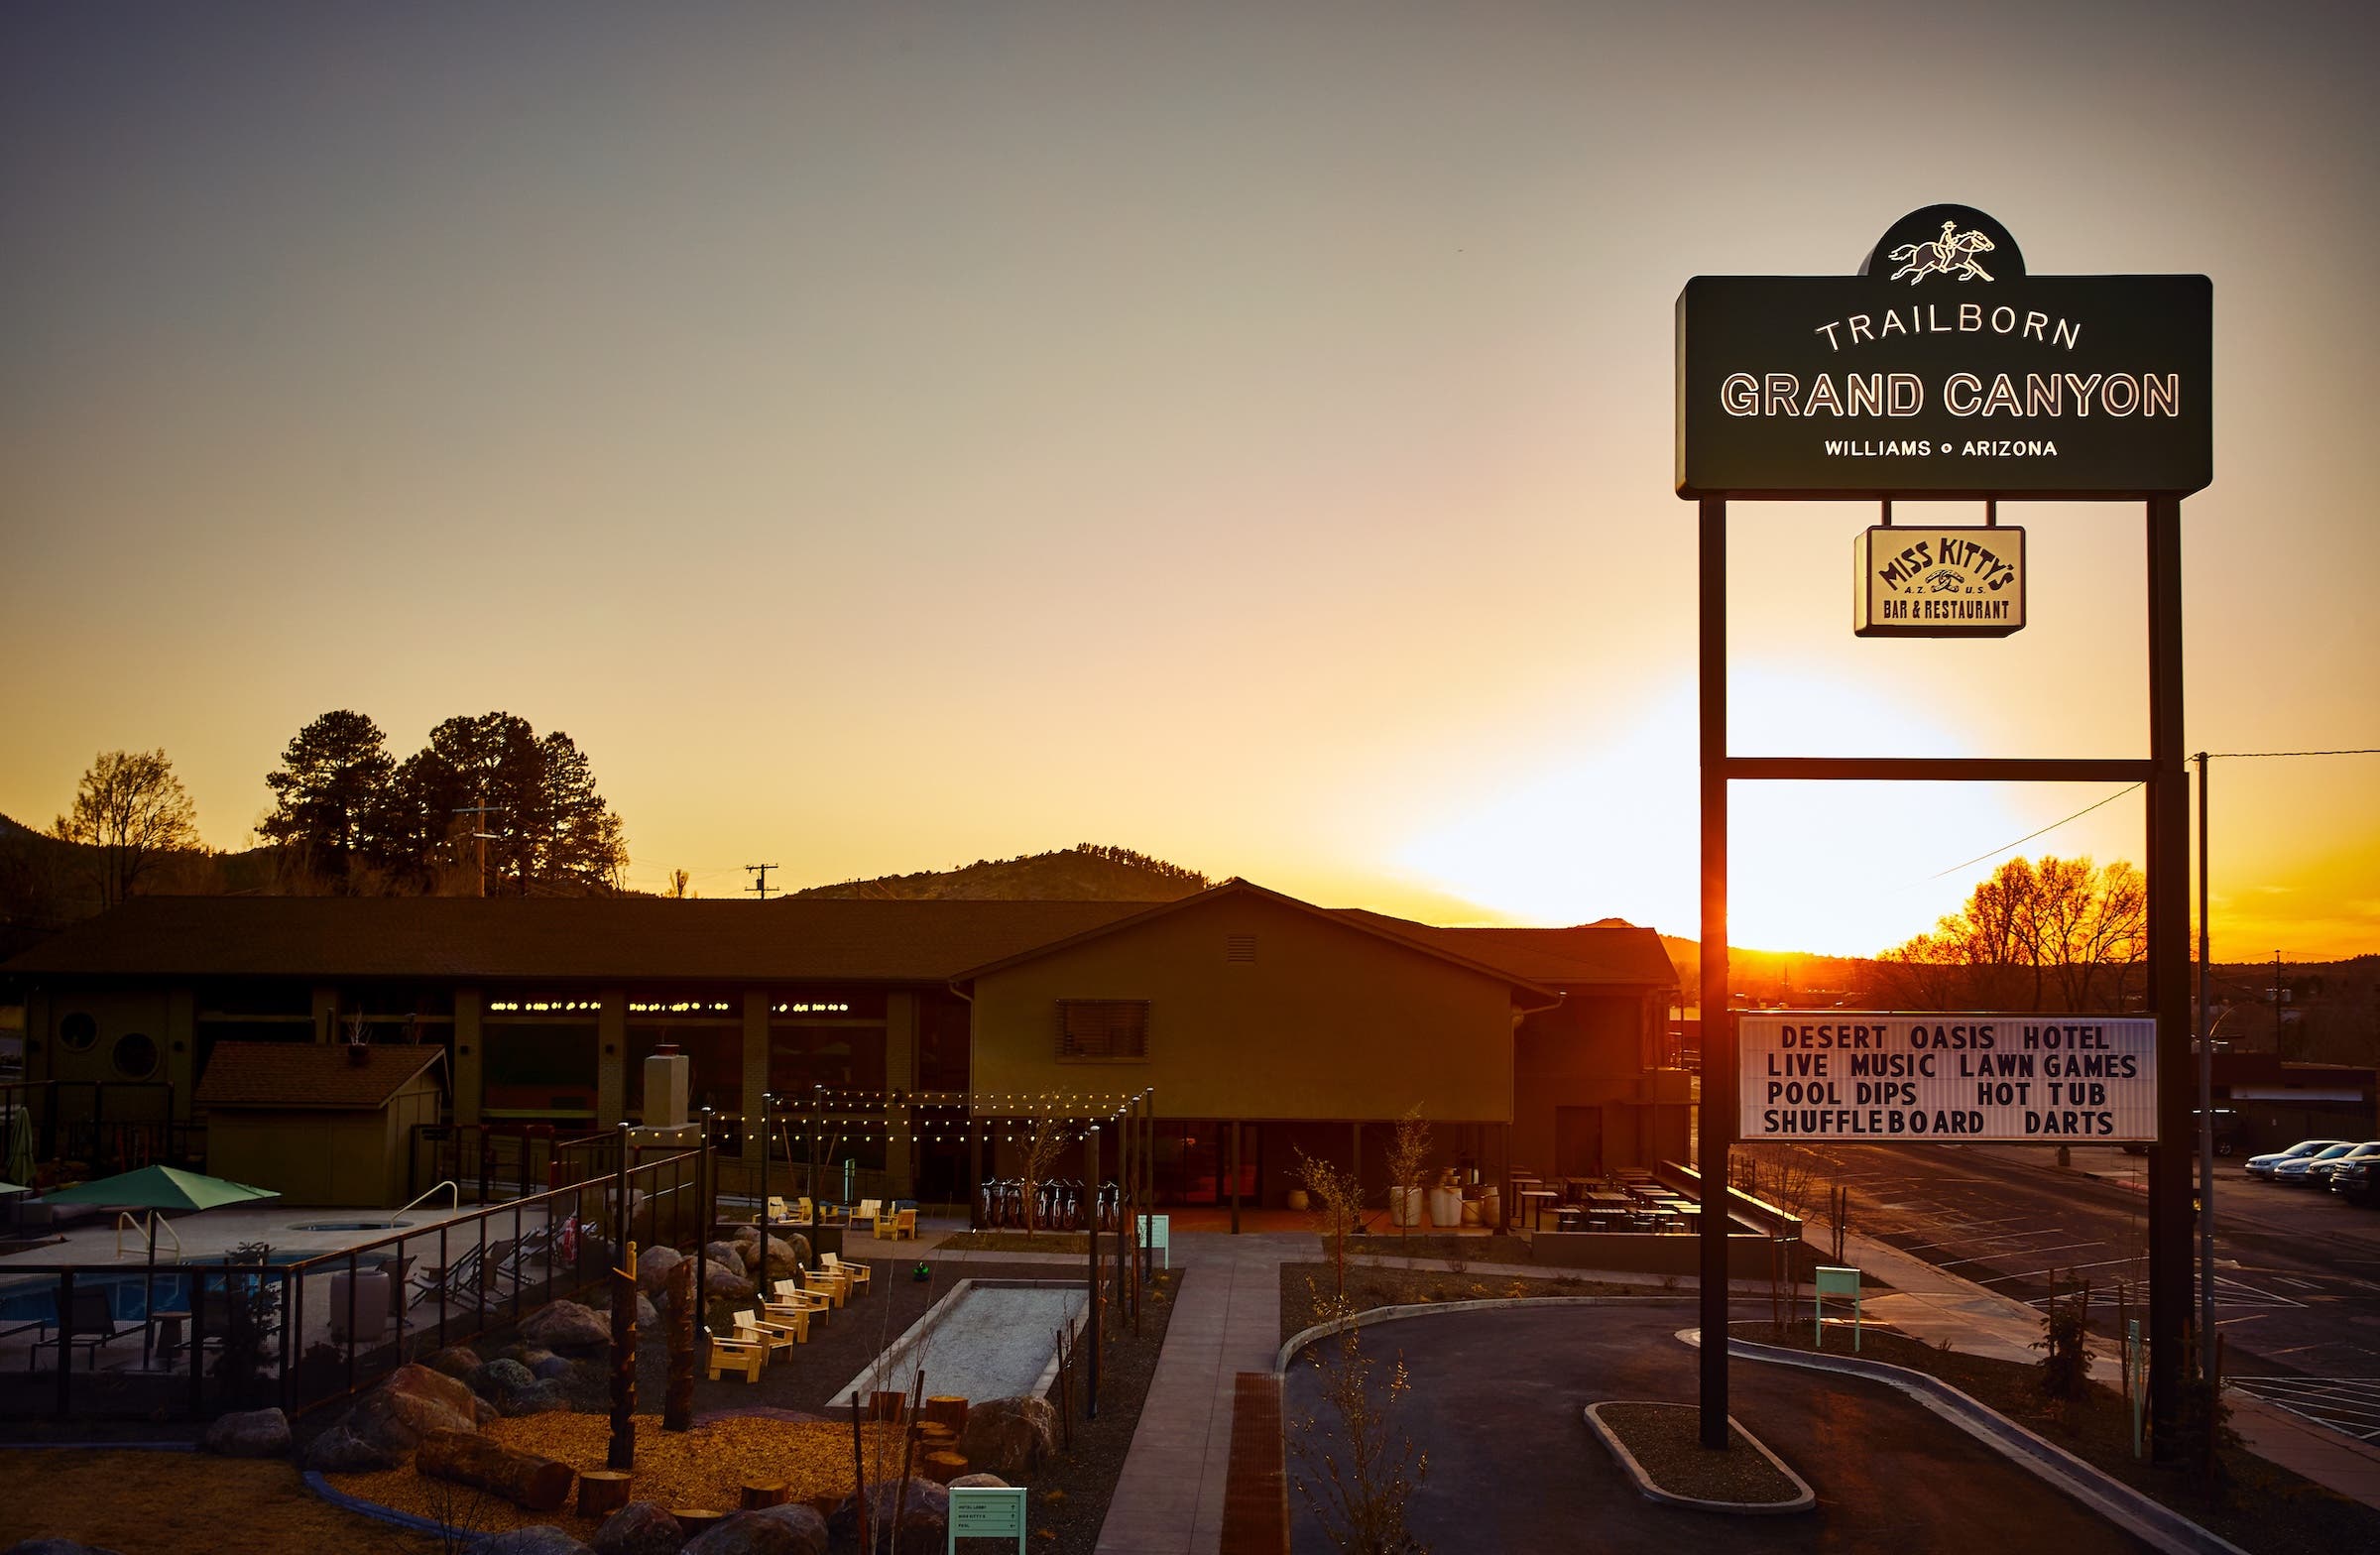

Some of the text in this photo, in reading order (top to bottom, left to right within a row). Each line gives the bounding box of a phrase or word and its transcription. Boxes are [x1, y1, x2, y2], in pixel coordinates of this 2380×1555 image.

[1815, 303, 2082, 351] TRAILBORN
[1721, 372, 2180, 418] GRAND CANYON
[1825, 440, 2058, 456] WILLIAMS ARIZONA
[1878, 538, 2015, 591] MISS KITTY'S
[1884, 600, 2009, 619] BAR & RESTAURANT
[1782, 1025, 2109, 1049] DESERT OASIS HOTEL
[1767, 1053, 2136, 1078] LIVE MUSIC LAWN GAMES
[1767, 1082, 2105, 1106] POOL DIPS HOT TUB
[1764, 1110, 2113, 1135] SHUFFLEBOARD DARTS
